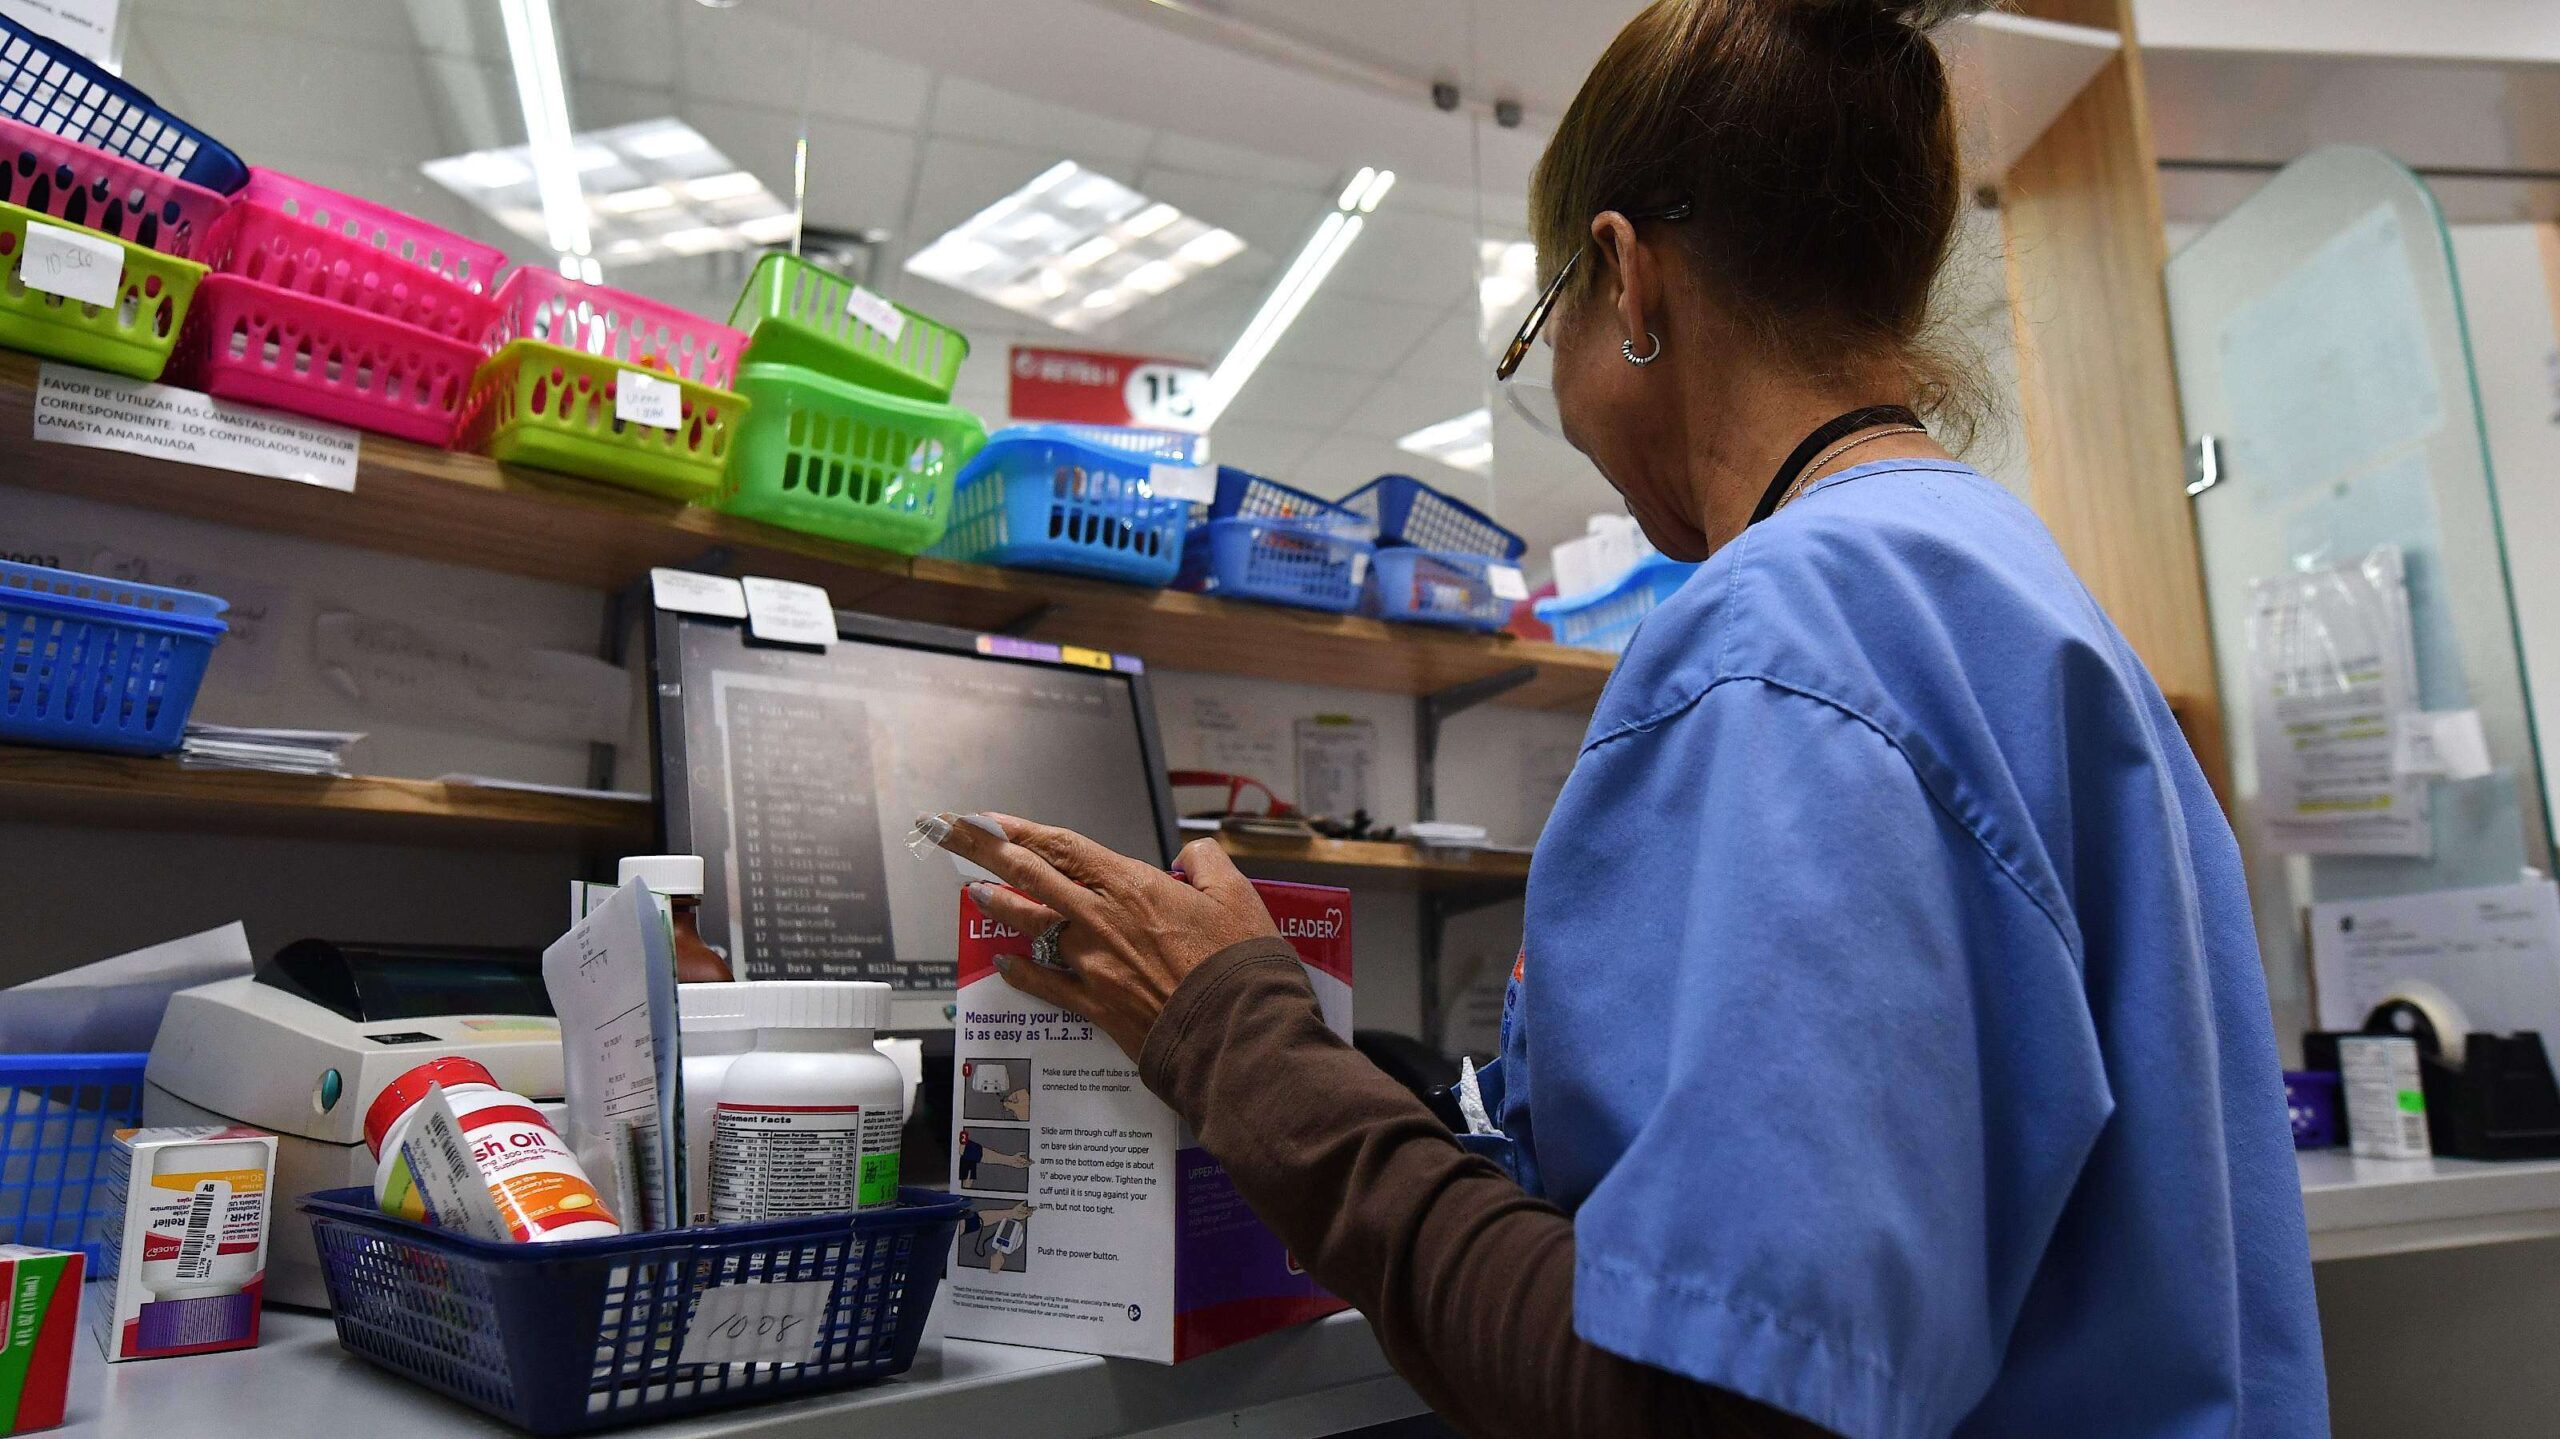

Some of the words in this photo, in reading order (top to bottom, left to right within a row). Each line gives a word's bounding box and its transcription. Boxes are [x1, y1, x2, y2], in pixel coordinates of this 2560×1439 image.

[1144, 372, 1194, 418] 15
[44, 377, 91, 396] FAVOR
[94, 387, 112, 401] DE
[116, 391, 174, 413] UTILIZAR
[177, 403, 199, 418] LAS
[203, 409, 267, 432] CANASTAS
[269, 422, 296, 438] CON
[299, 430, 315, 443] SU
[316, 434, 354, 451] COLOR
[38, 414, 102, 435] CANASTA
[105, 426, 196, 452] ANARANJADA
[40, 396, 175, 430] CORRESPONDIENTE.
[182, 423, 206, 437] LOS
[209, 427, 301, 456] CONTROLADOS
[303, 449, 327, 463] VAN
[330, 455, 346, 467] EN
[1280, 917, 1335, 940] LEADER
[867, 964, 908, 976] Billing
[965, 1010, 1026, 1026] Measuring
[1030, 1012, 1058, 1026] your
[964, 1027, 974, 1041] is
[977, 1030, 991, 1041] as
[993, 1030, 1022, 1043] easy
[1026, 1030, 1040, 1041] as
[1044, 1027, 1094, 1041] 1...2...3!
[1042, 1068, 1061, 1077] Make
[1062, 1068, 1077, 1077] sure
[1078, 1068, 1090, 1077] the
[1091, 1068, 1105, 1077] cuff
[1106, 1069, 1122, 1077] tube
[1123, 1069, 1130, 1078] is
[1042, 1083, 1079, 1091] connected
[1089, 1083, 1100, 1092] the
[1101, 1084, 1132, 1092] monitor.
[761, 1115, 792, 1124] Facts
[1041, 1126, 1058, 1135] Slide
[1059, 1128, 1073, 1136] arm
[1074, 1128, 1102, 1138] through
[1103, 1128, 1118, 1138] cuff
[1118, 1130, 1127, 1138] as
[1128, 1130, 1153, 1139] shown
[474, 1140, 506, 1163] sh
[509, 1132, 547, 1149] Oil
[1040, 1142, 1050, 1150] on
[1051, 1142, 1067, 1150] bare
[1068, 1142, 1082, 1151] skin
[1083, 1143, 1109, 1152] around
[1109, 1145, 1126, 1154] your
[1127, 1146, 1150, 1155] upper
[502, 1149, 522, 1161] 300
[492, 1154, 546, 1173] Supplement
[1040, 1157, 1054, 1165] arm
[1055, 1158, 1064, 1166] so
[1065, 1158, 1077, 1166] the
[1077, 1158, 1105, 1167] bottom
[1105, 1160, 1125, 1170] edge
[1125, 1160, 1132, 1169] is
[1132, 1161, 1155, 1170] about
[1050, 1172, 1072, 1180] above
[1072, 1174, 1089, 1183] your
[1090, 1174, 1114, 1183] elbow.
[1115, 1175, 1143, 1186] Tighten
[1144, 1176, 1157, 1186] the
[1188, 1166, 1213, 1180] UPPER
[202, 1183, 216, 1193] AB
[1039, 1187, 1054, 1195] cuff
[1054, 1187, 1070, 1195] until
[1070, 1188, 1076, 1196] it
[1077, 1188, 1083, 1197] is
[1084, 1190, 1102, 1199] snug
[1103, 1191, 1129, 1200] against
[1130, 1193, 1148, 1202] your
[226, 1205, 261, 1213] Fexofenadi
[239, 1199, 262, 1207] Tablets
[1039, 1202, 1055, 1211] arm,
[1055, 1202, 1068, 1211] but
[1069, 1203, 1081, 1212] not
[1082, 1204, 1095, 1213] too
[1096, 1205, 1116, 1215] tight.
[152, 1217, 186, 1229] Relief
[230, 1211, 261, 1223] 24HR
[693, 1213, 706, 1223] AB
[154, 1244, 180, 1254] EADER
[1037, 1246, 1055, 1256] Push
[1056, 1248, 1068, 1257] the
[1069, 1250, 1092, 1259] power
[1093, 1250, 1120, 1262] button.
